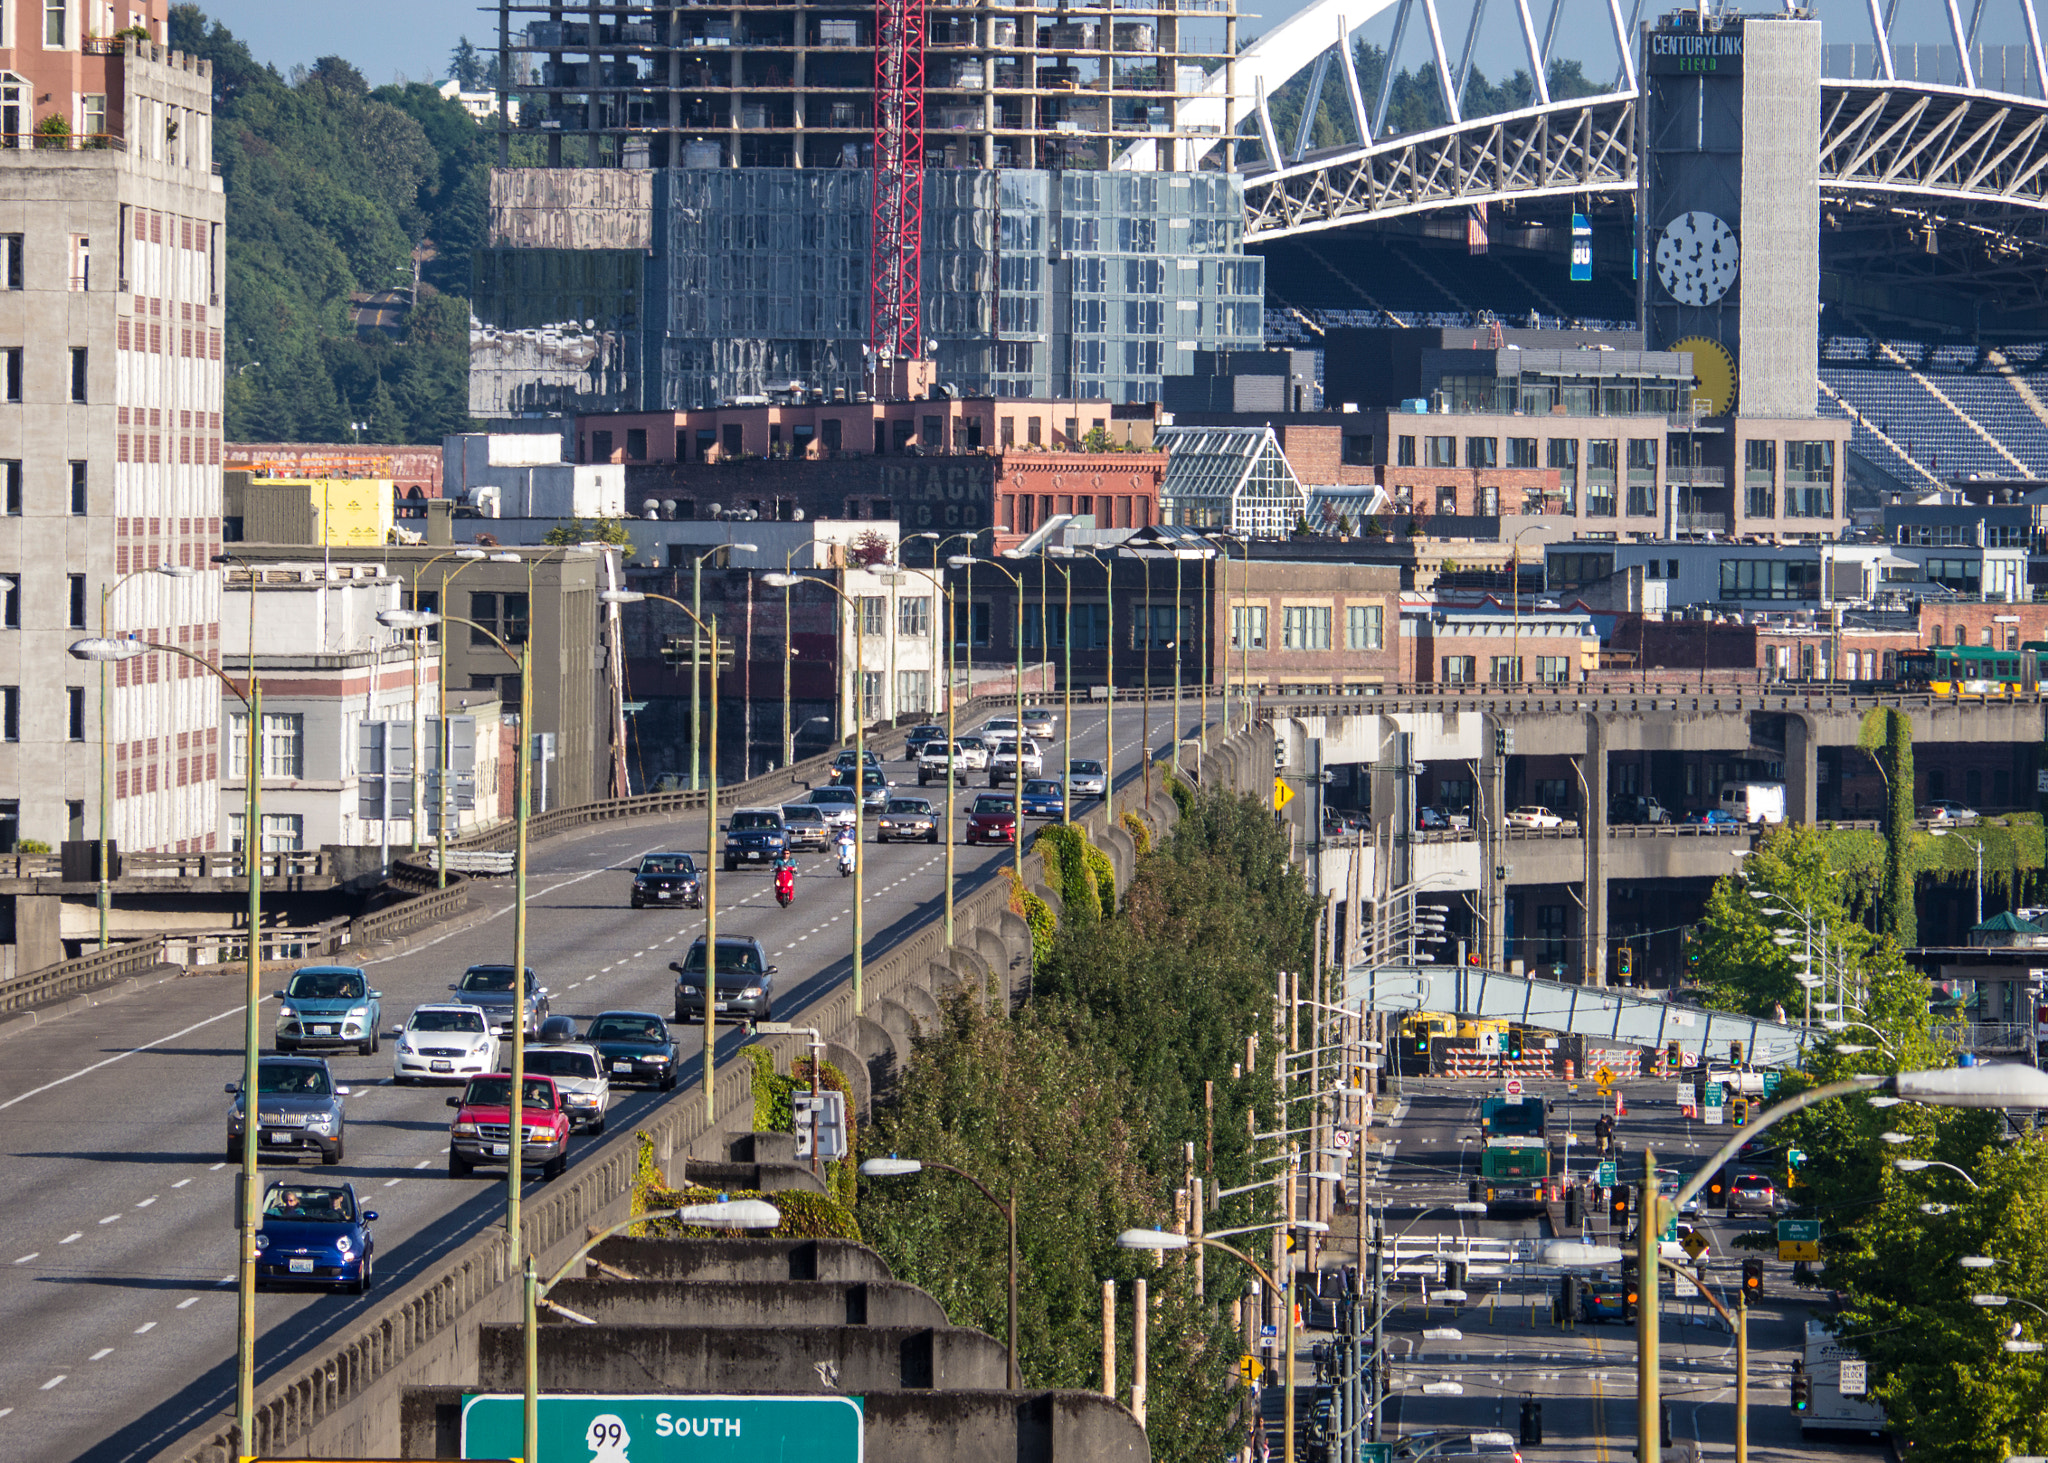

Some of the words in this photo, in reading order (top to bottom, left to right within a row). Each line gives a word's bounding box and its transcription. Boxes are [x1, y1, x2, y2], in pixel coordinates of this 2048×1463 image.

[1652, 34, 1742, 55] CENTURYLINK
[1680, 57, 1716, 71] FIELD
[1843, 1371, 1863, 1379] BLOCK
[593, 1423, 622, 1448] 99
